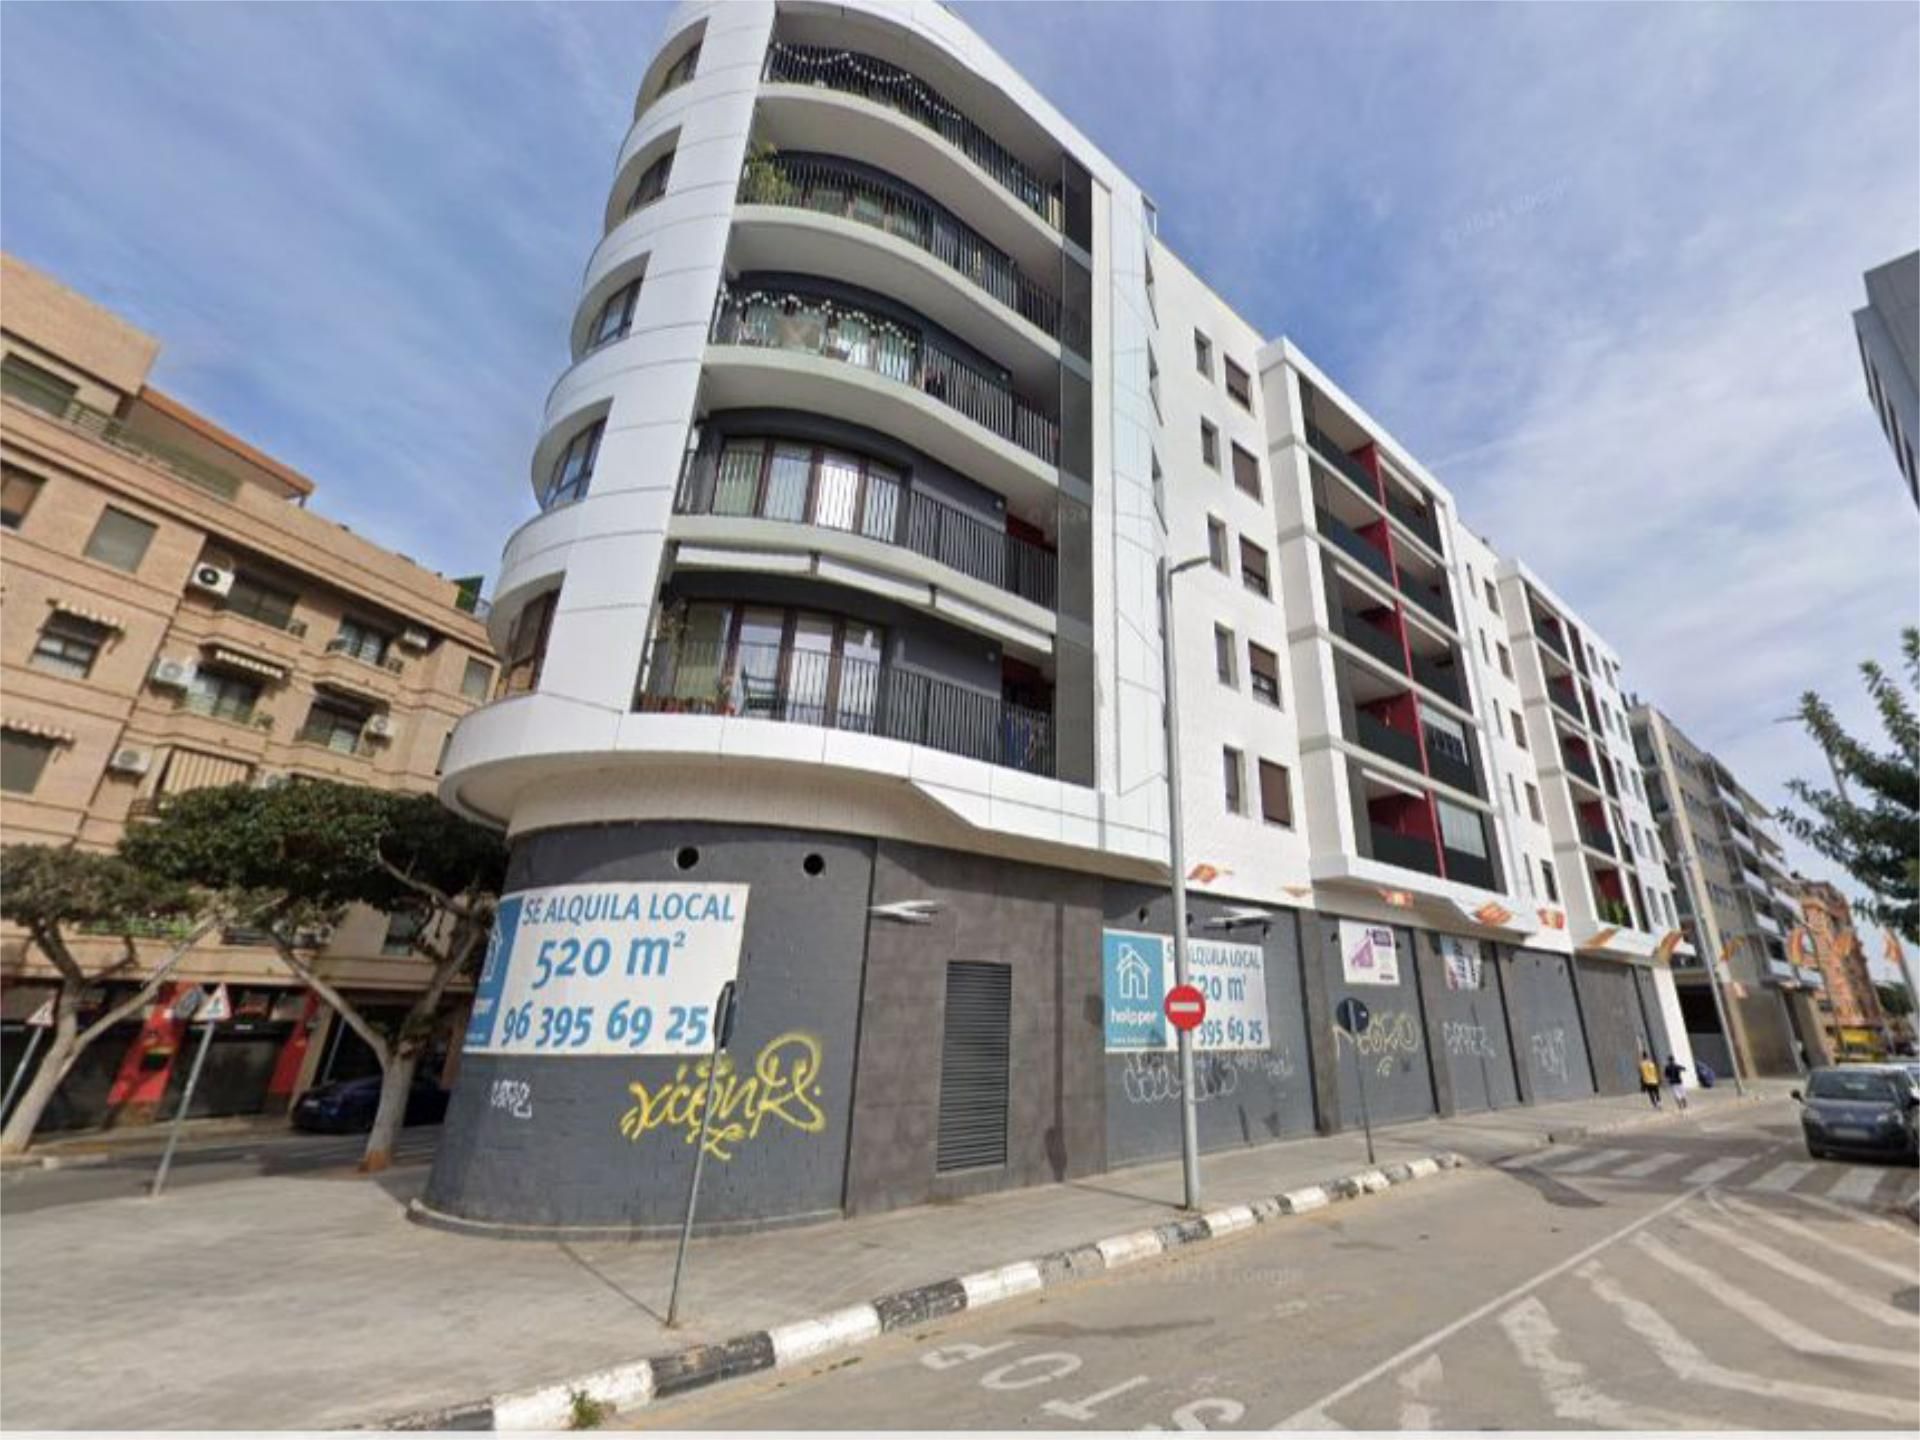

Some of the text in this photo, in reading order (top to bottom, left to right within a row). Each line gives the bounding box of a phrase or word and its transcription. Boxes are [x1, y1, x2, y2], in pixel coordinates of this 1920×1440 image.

[522, 893, 736, 926] SE ALQUILA LOCAL
[531, 937, 612, 989] 520
[1229, 950, 1262, 970] LOCAL
[501, 1001, 533, 1047] 96
[535, 1006, 593, 1048] 395
[606, 998, 653, 1047] 69
[664, 1006, 709, 1046] 25
[1227, 1016, 1244, 1046] 69
[1248, 1019, 1262, 1046] 25
